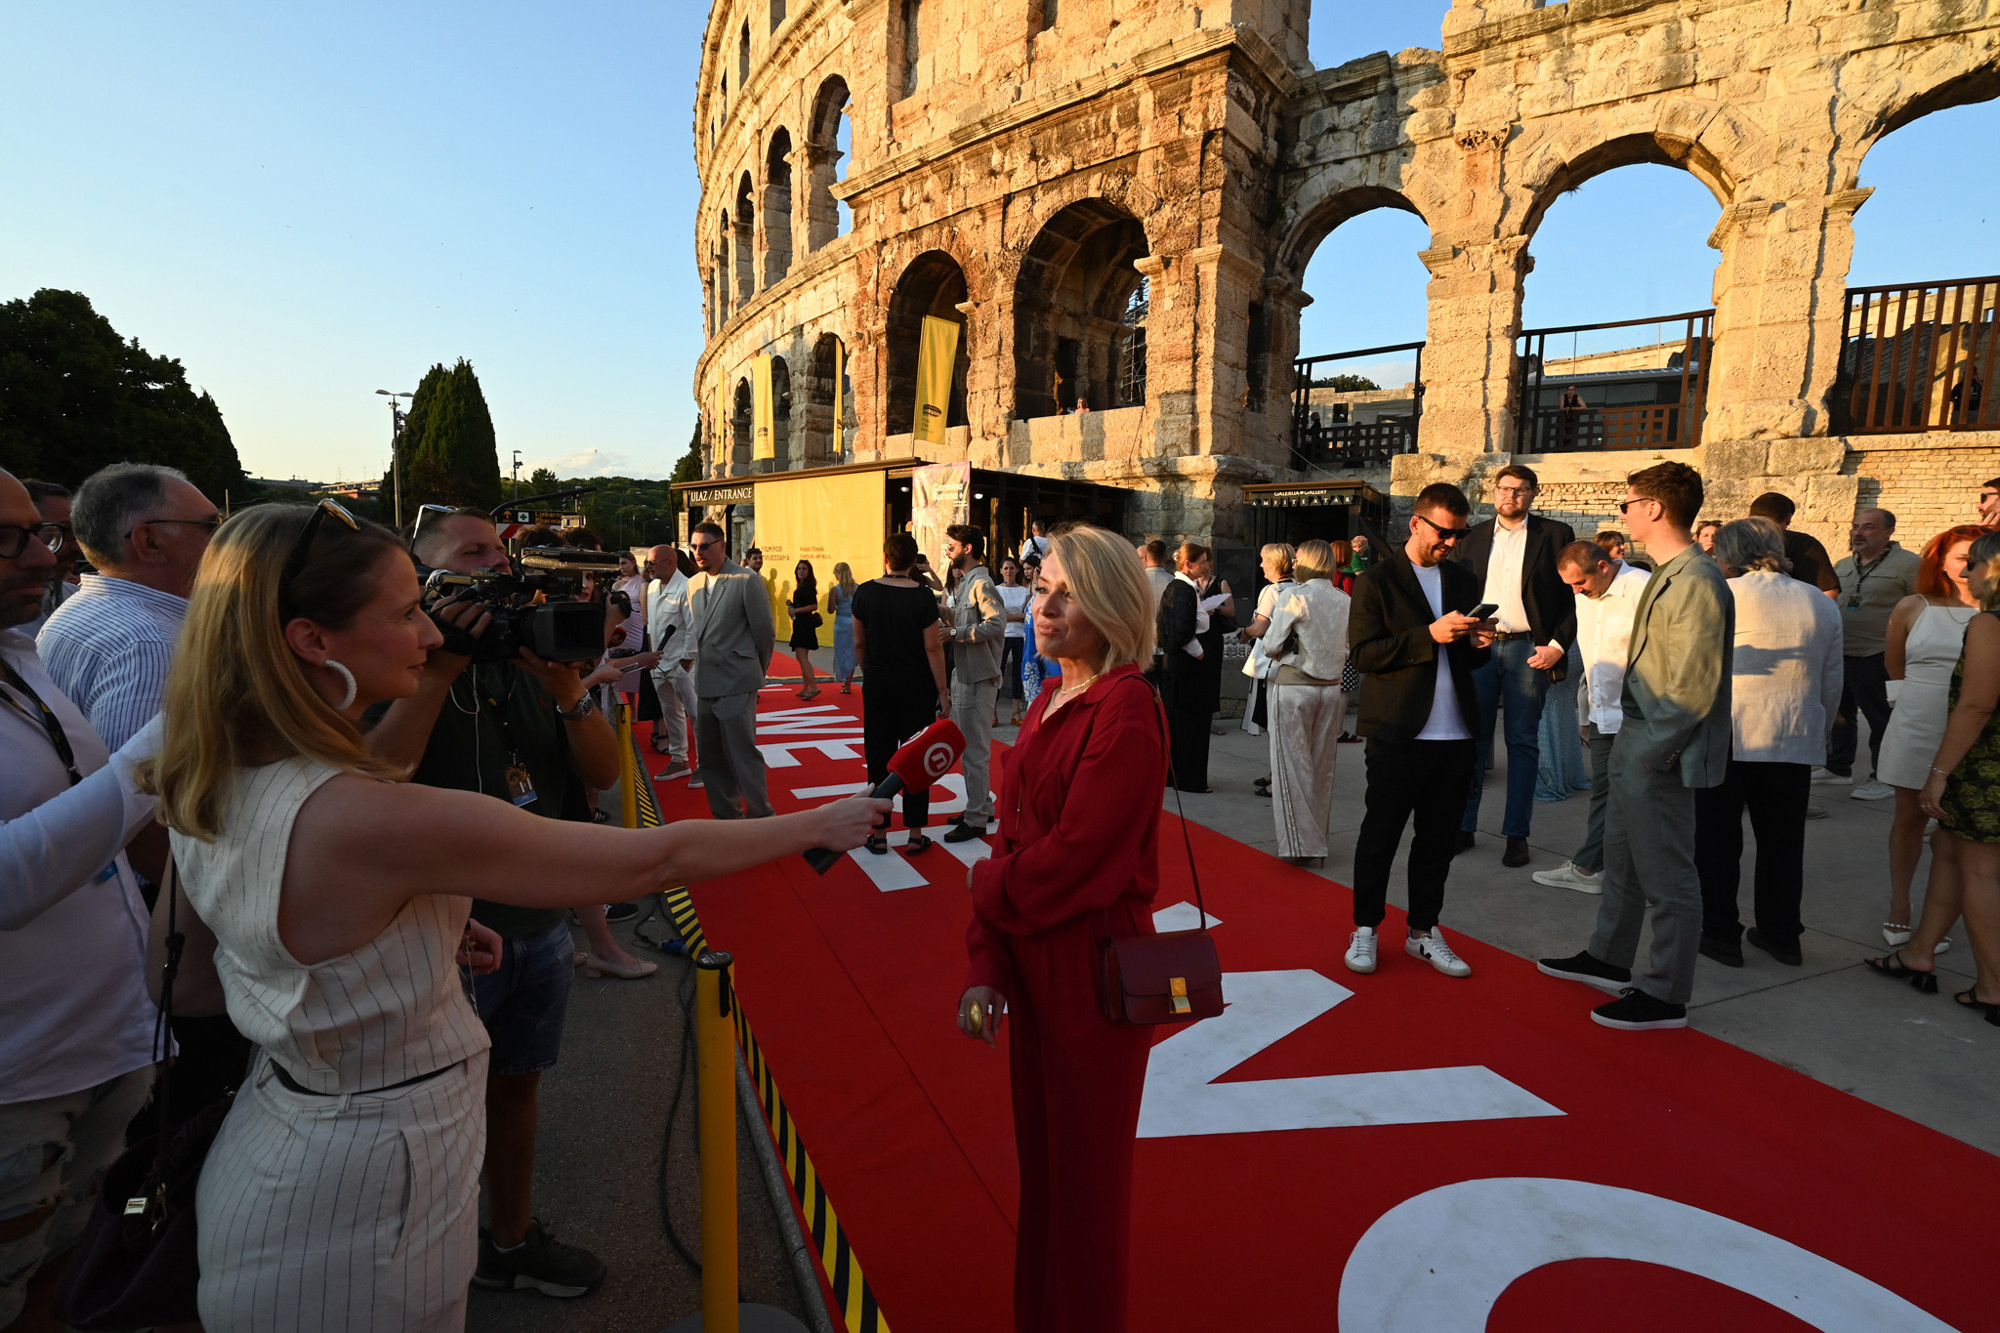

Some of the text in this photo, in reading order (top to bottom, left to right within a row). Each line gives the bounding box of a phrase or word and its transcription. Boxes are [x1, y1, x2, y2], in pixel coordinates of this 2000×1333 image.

[933, 482, 963, 492] Carmina
[690, 490, 708, 502] ULAZ
[714, 487, 753, 500] ENTRANCE
[1252, 496, 1352, 507] AMFITEATAR
